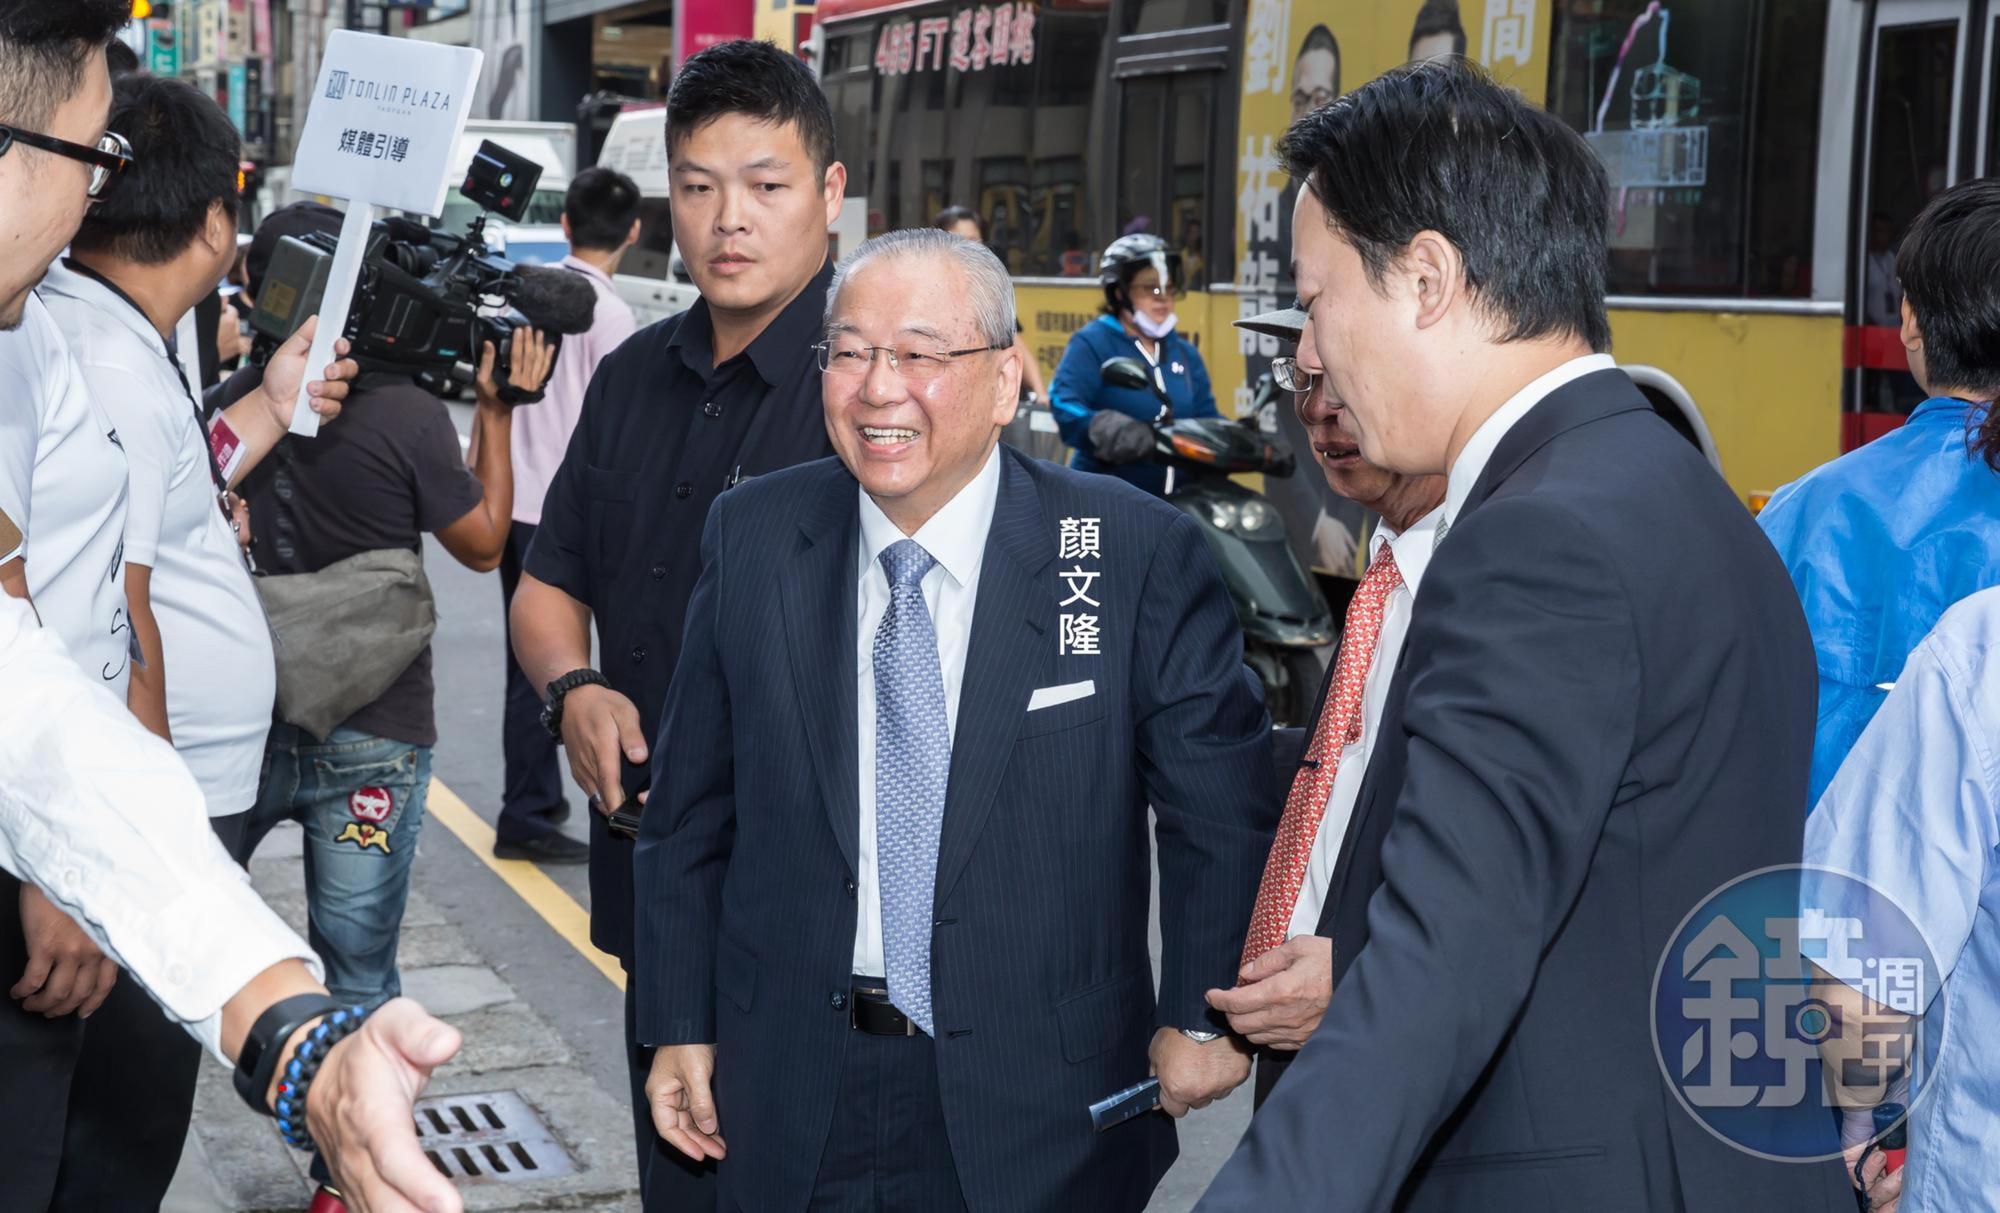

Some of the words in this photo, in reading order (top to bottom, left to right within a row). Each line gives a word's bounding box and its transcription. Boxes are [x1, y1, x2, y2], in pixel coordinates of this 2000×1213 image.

[348, 79, 398, 103] TONLIN
[401, 87, 450, 111] PLAZA
[337, 127, 410, 163] 媒體引導
